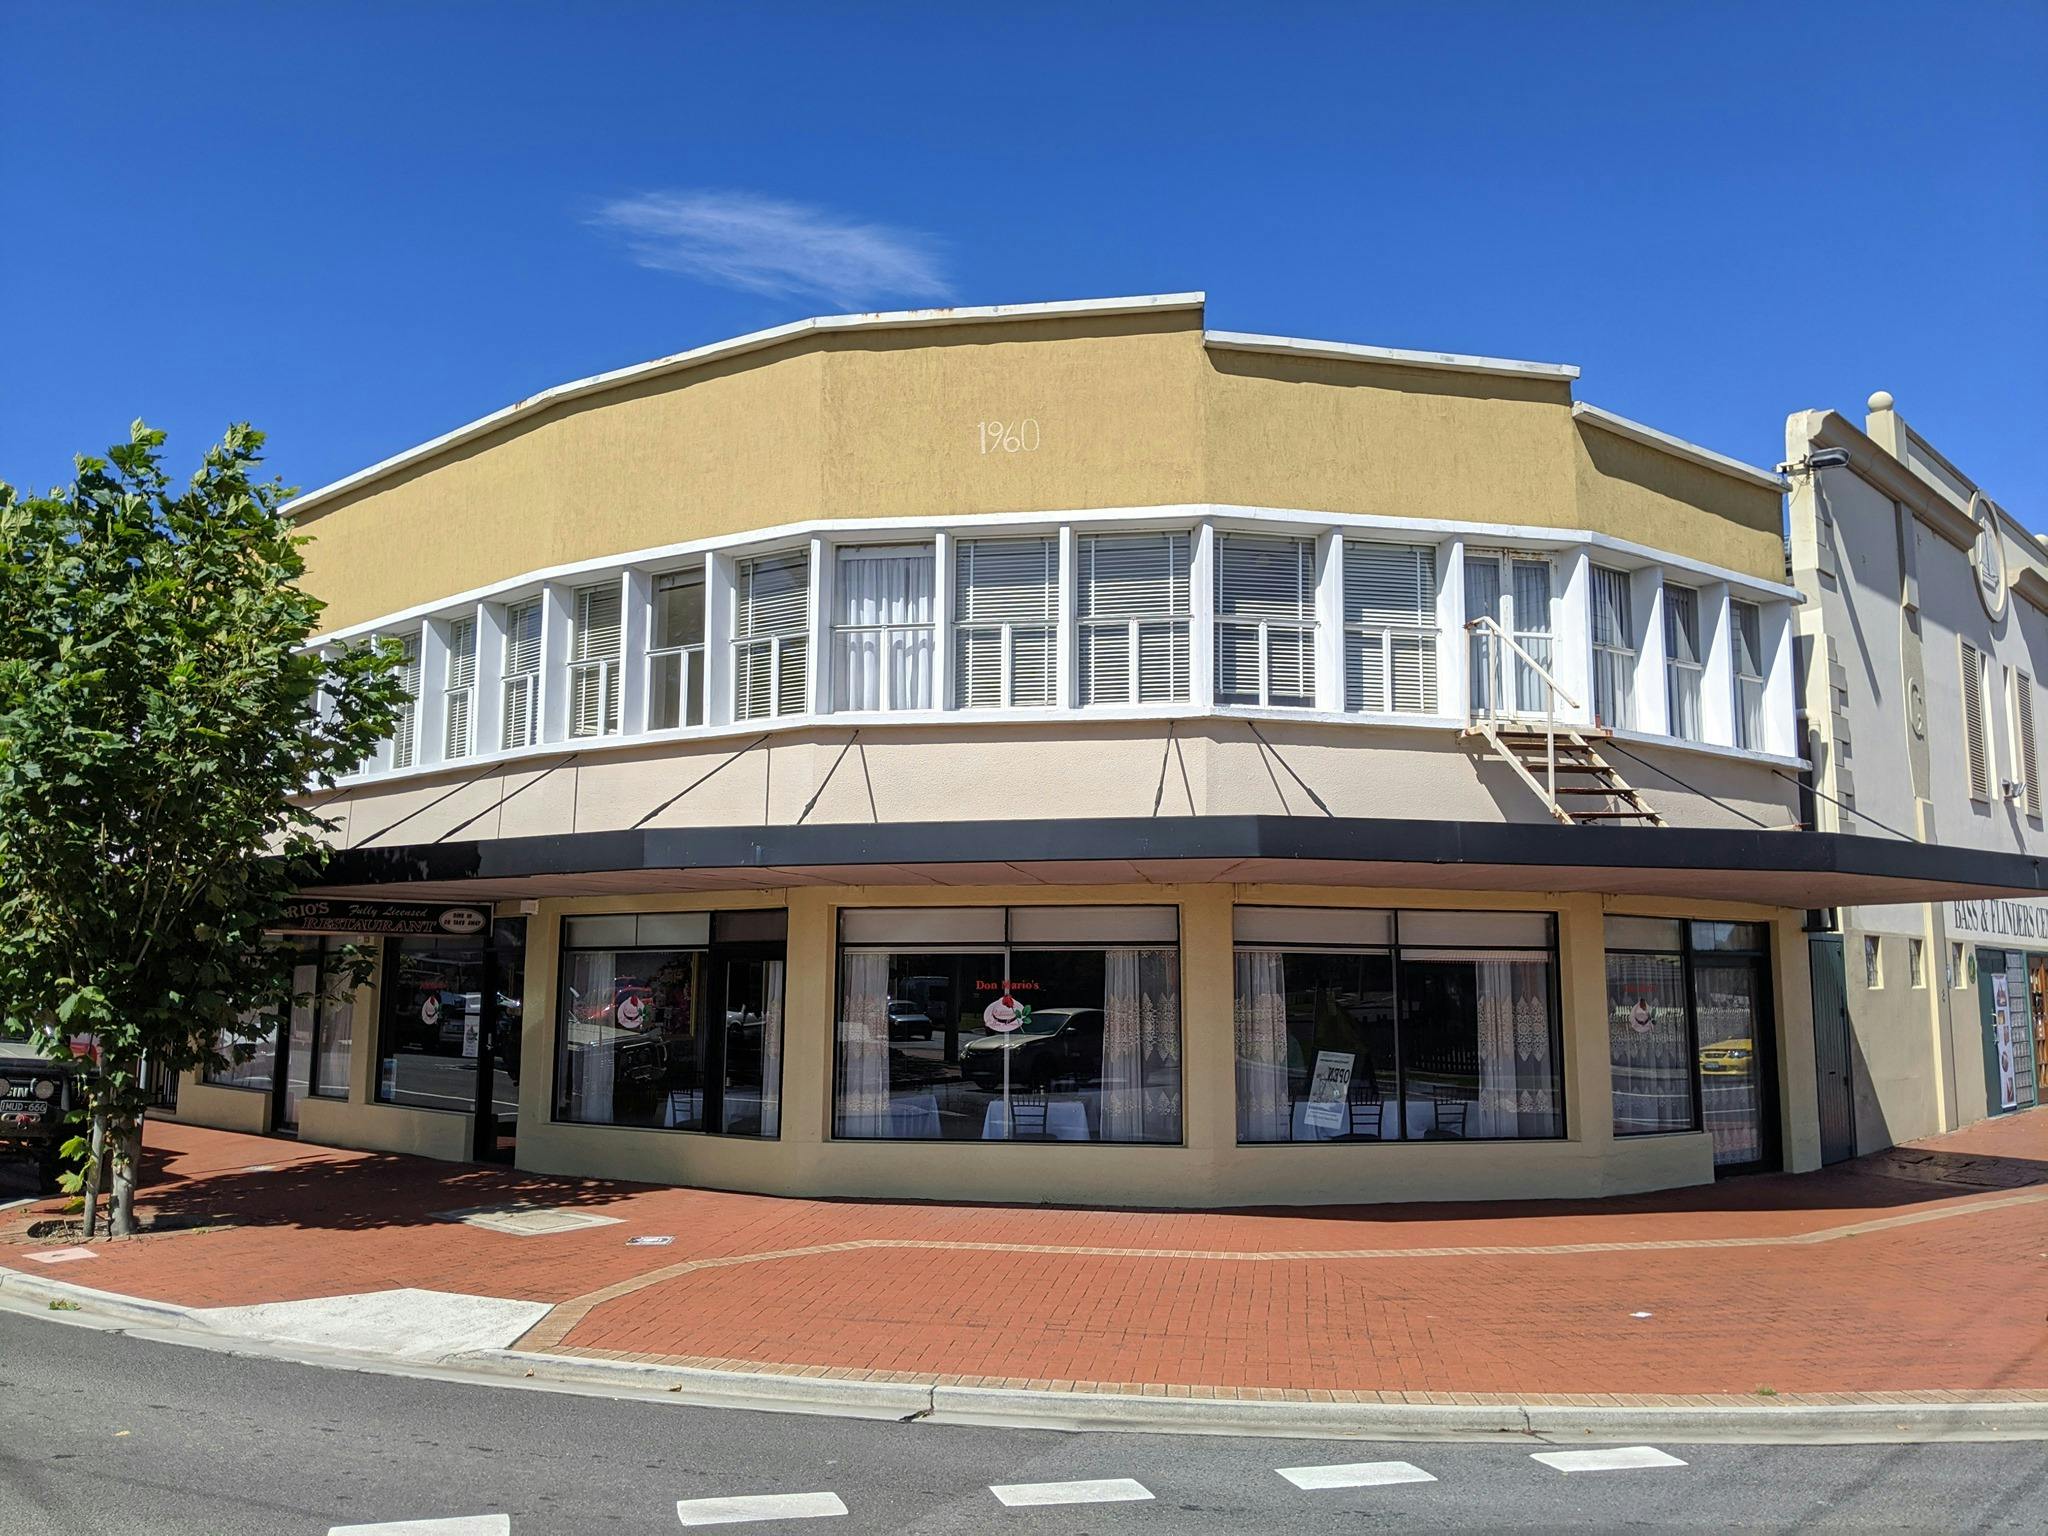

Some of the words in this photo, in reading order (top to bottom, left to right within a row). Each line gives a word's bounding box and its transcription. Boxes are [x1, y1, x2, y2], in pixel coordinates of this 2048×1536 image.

[977, 418, 1040, 454] 1960
[348, 904, 378, 918] Fully
[382, 906, 429, 917] Licensed
[1980, 899, 1989, 932] &
[1990, 899, 2035, 938] FLINDERS
[302, 917, 437, 933] RESTAURANT
[976, 980, 998, 990] Don
[1002, 980, 1040, 990] Mario's
